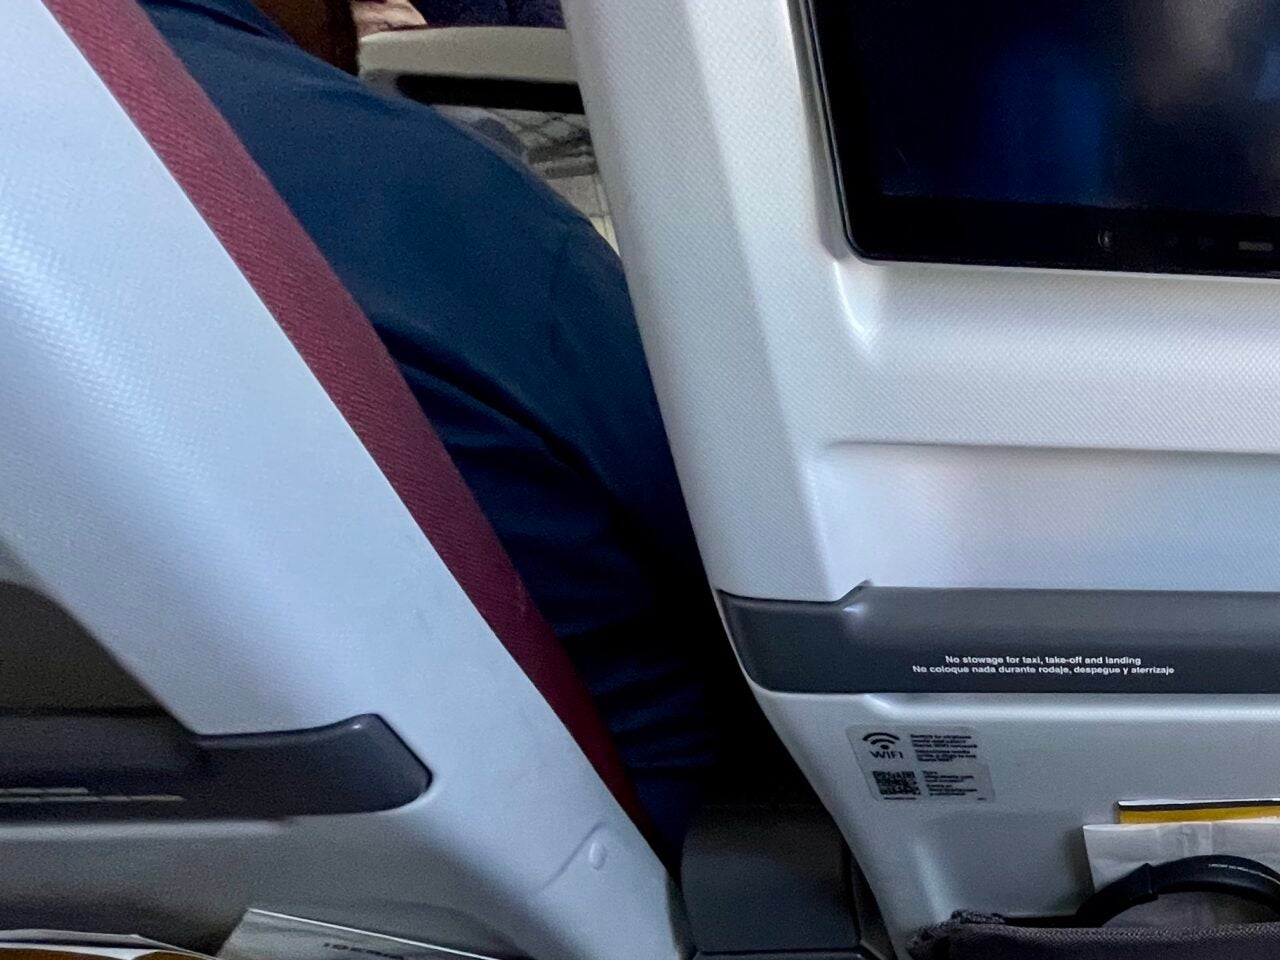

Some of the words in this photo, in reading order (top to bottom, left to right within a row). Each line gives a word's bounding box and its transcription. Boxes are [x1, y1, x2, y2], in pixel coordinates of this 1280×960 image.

[945, 656, 961, 664] No
[962, 656, 1004, 665] stowage
[1006, 656, 1020, 664] for
[1022, 656, 1044, 664] taxi,
[1045, 656, 1082, 664] take-off
[1085, 656, 1103, 664] and
[1105, 656, 1141, 665] landing
[912, 665, 927, 673] No
[929, 666, 969, 675] coloque
[1038, 666, 1072, 675] rodaje,
[1074, 666, 1120, 675] despegue
[1131, 666, 1175, 676] aterrizaje
